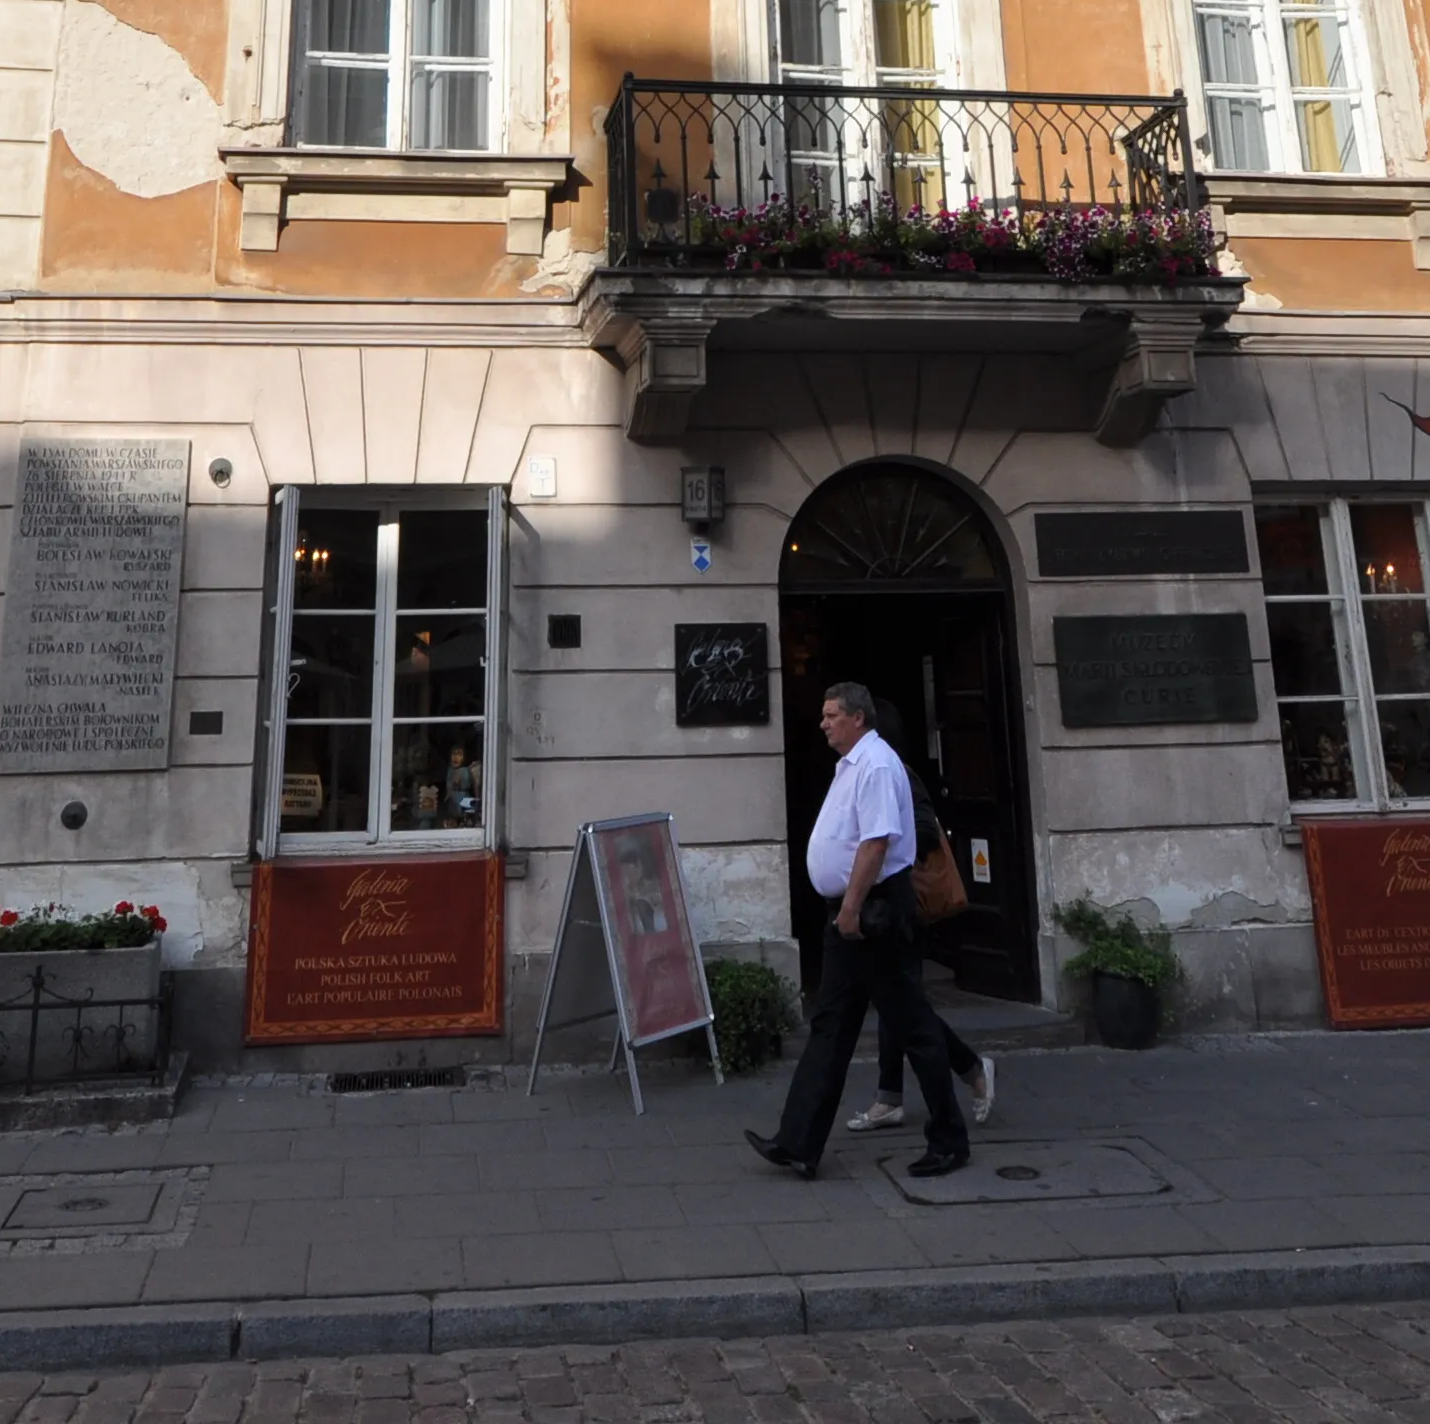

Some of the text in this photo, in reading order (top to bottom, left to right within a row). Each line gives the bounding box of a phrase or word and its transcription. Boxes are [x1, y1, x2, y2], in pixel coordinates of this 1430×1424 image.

[119, 448, 158, 458] CZASIE
[687, 479, 705, 502] 16
[112, 580, 169, 591] NOWICKI
[27, 642, 85, 655] EDWARD
[1124, 687, 1197, 705] CURIE
[1337, 944, 1356, 956] LES
[295, 951, 457, 970] POLSKA SZTUKA LUDOWA
[1360, 959, 1380, 971] LES
[320, 970, 431, 986] POLISH FOLK ART
[324, 989, 394, 1004] POPULAIRE
[399, 985, 463, 1000] POLONAIS
